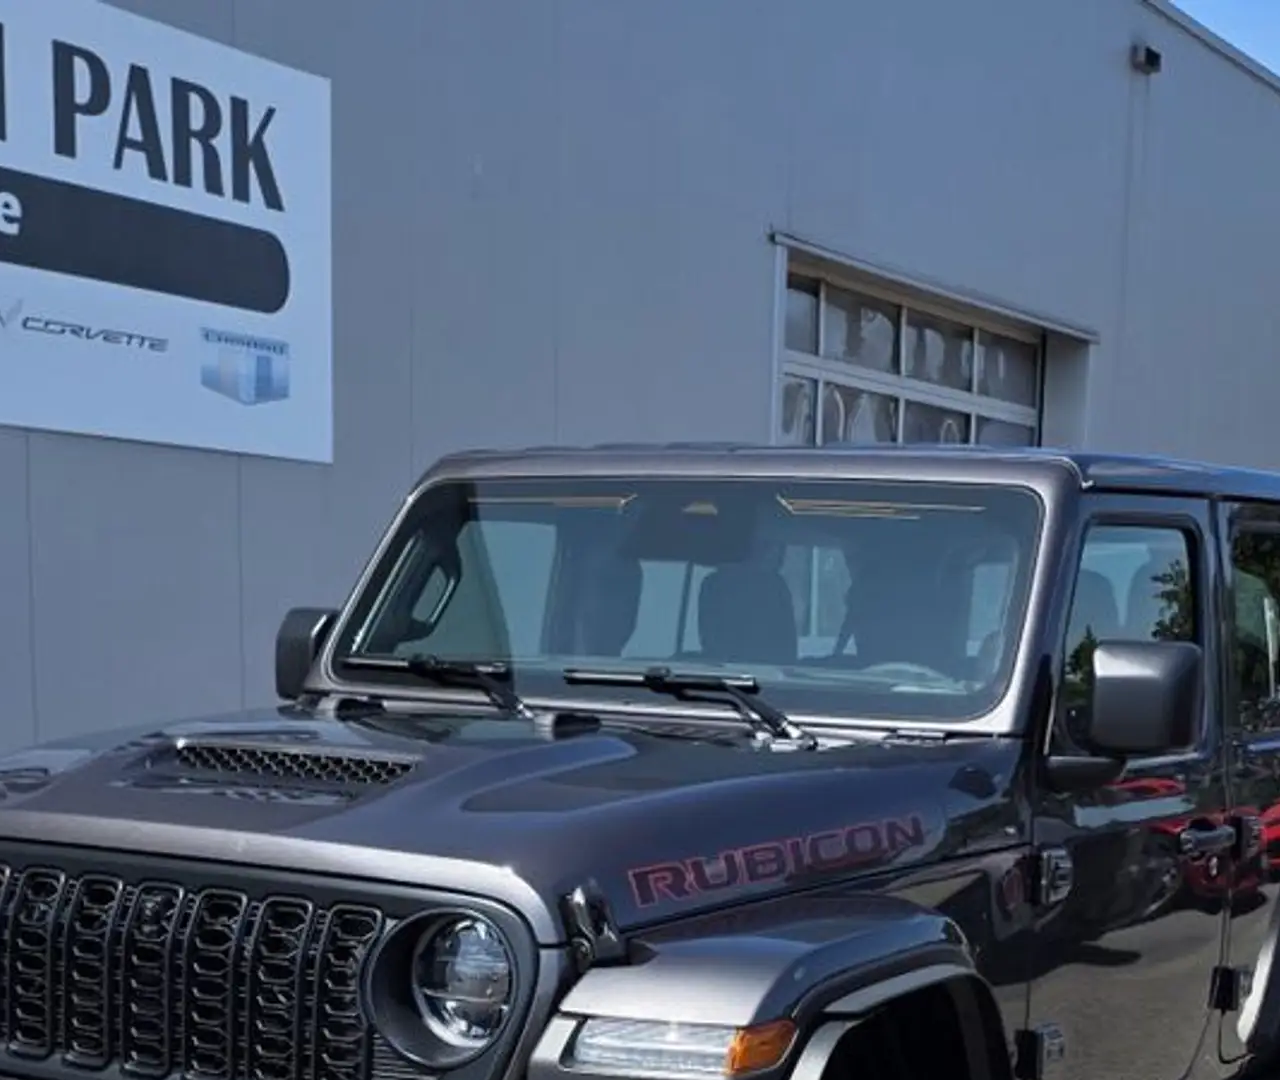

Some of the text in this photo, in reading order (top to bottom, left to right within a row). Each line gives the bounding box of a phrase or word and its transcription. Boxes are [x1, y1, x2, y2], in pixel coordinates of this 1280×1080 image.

[52, 39, 285, 212] PARK
[22, 316, 169, 353] CORVETTE
[628, 816, 924, 907] RUBICON
